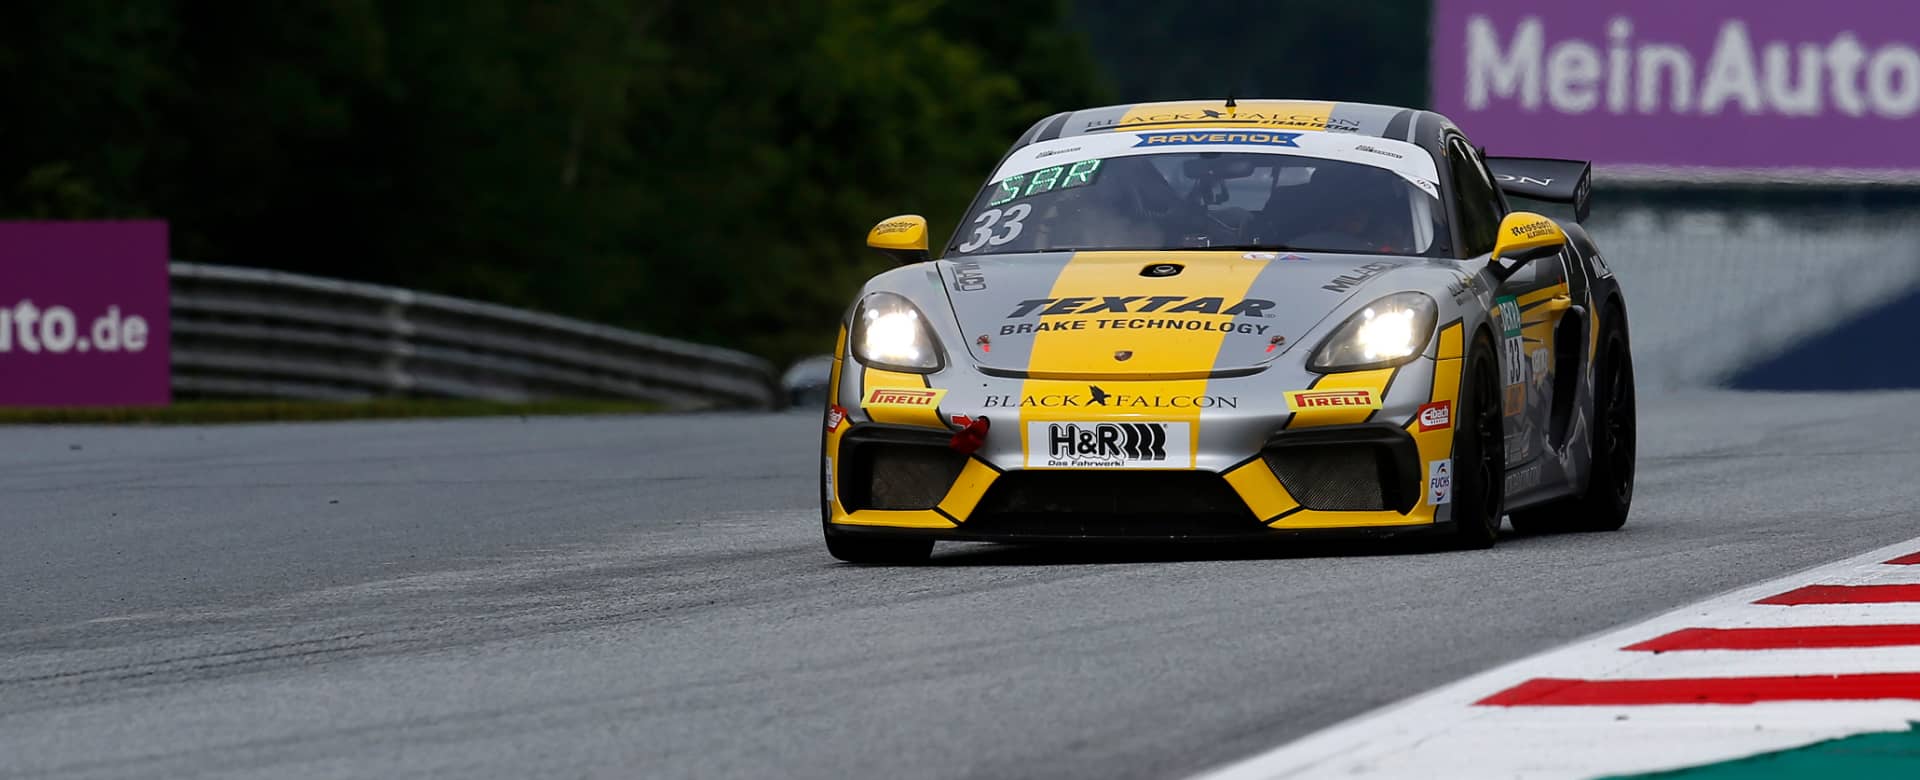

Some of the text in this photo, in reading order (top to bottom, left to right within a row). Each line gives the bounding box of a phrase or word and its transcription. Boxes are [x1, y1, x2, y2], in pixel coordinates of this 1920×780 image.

[1464, 14, 1920, 118] MeinAuto
[1087, 112, 1361, 128] BLACK FALCON
[1147, 133, 1288, 144] RAVENOL
[991, 159, 1101, 206] SAR
[959, 203, 1032, 253] 33
[1007, 296, 1277, 319] TEXTAR
[1000, 318, 1271, 336] BRAKE TECHNOLOGY
[1508, 338, 1521, 383] 33
[869, 389, 937, 405] PIRELLI
[983, 394, 1238, 409] BLACK FALCON
[1294, 390, 1372, 408] PIRELLI
[1049, 423, 1126, 460] H&R
[1048, 459, 1125, 467] Das Fahrwerk!
[1431, 476, 1450, 489] FUCHS
